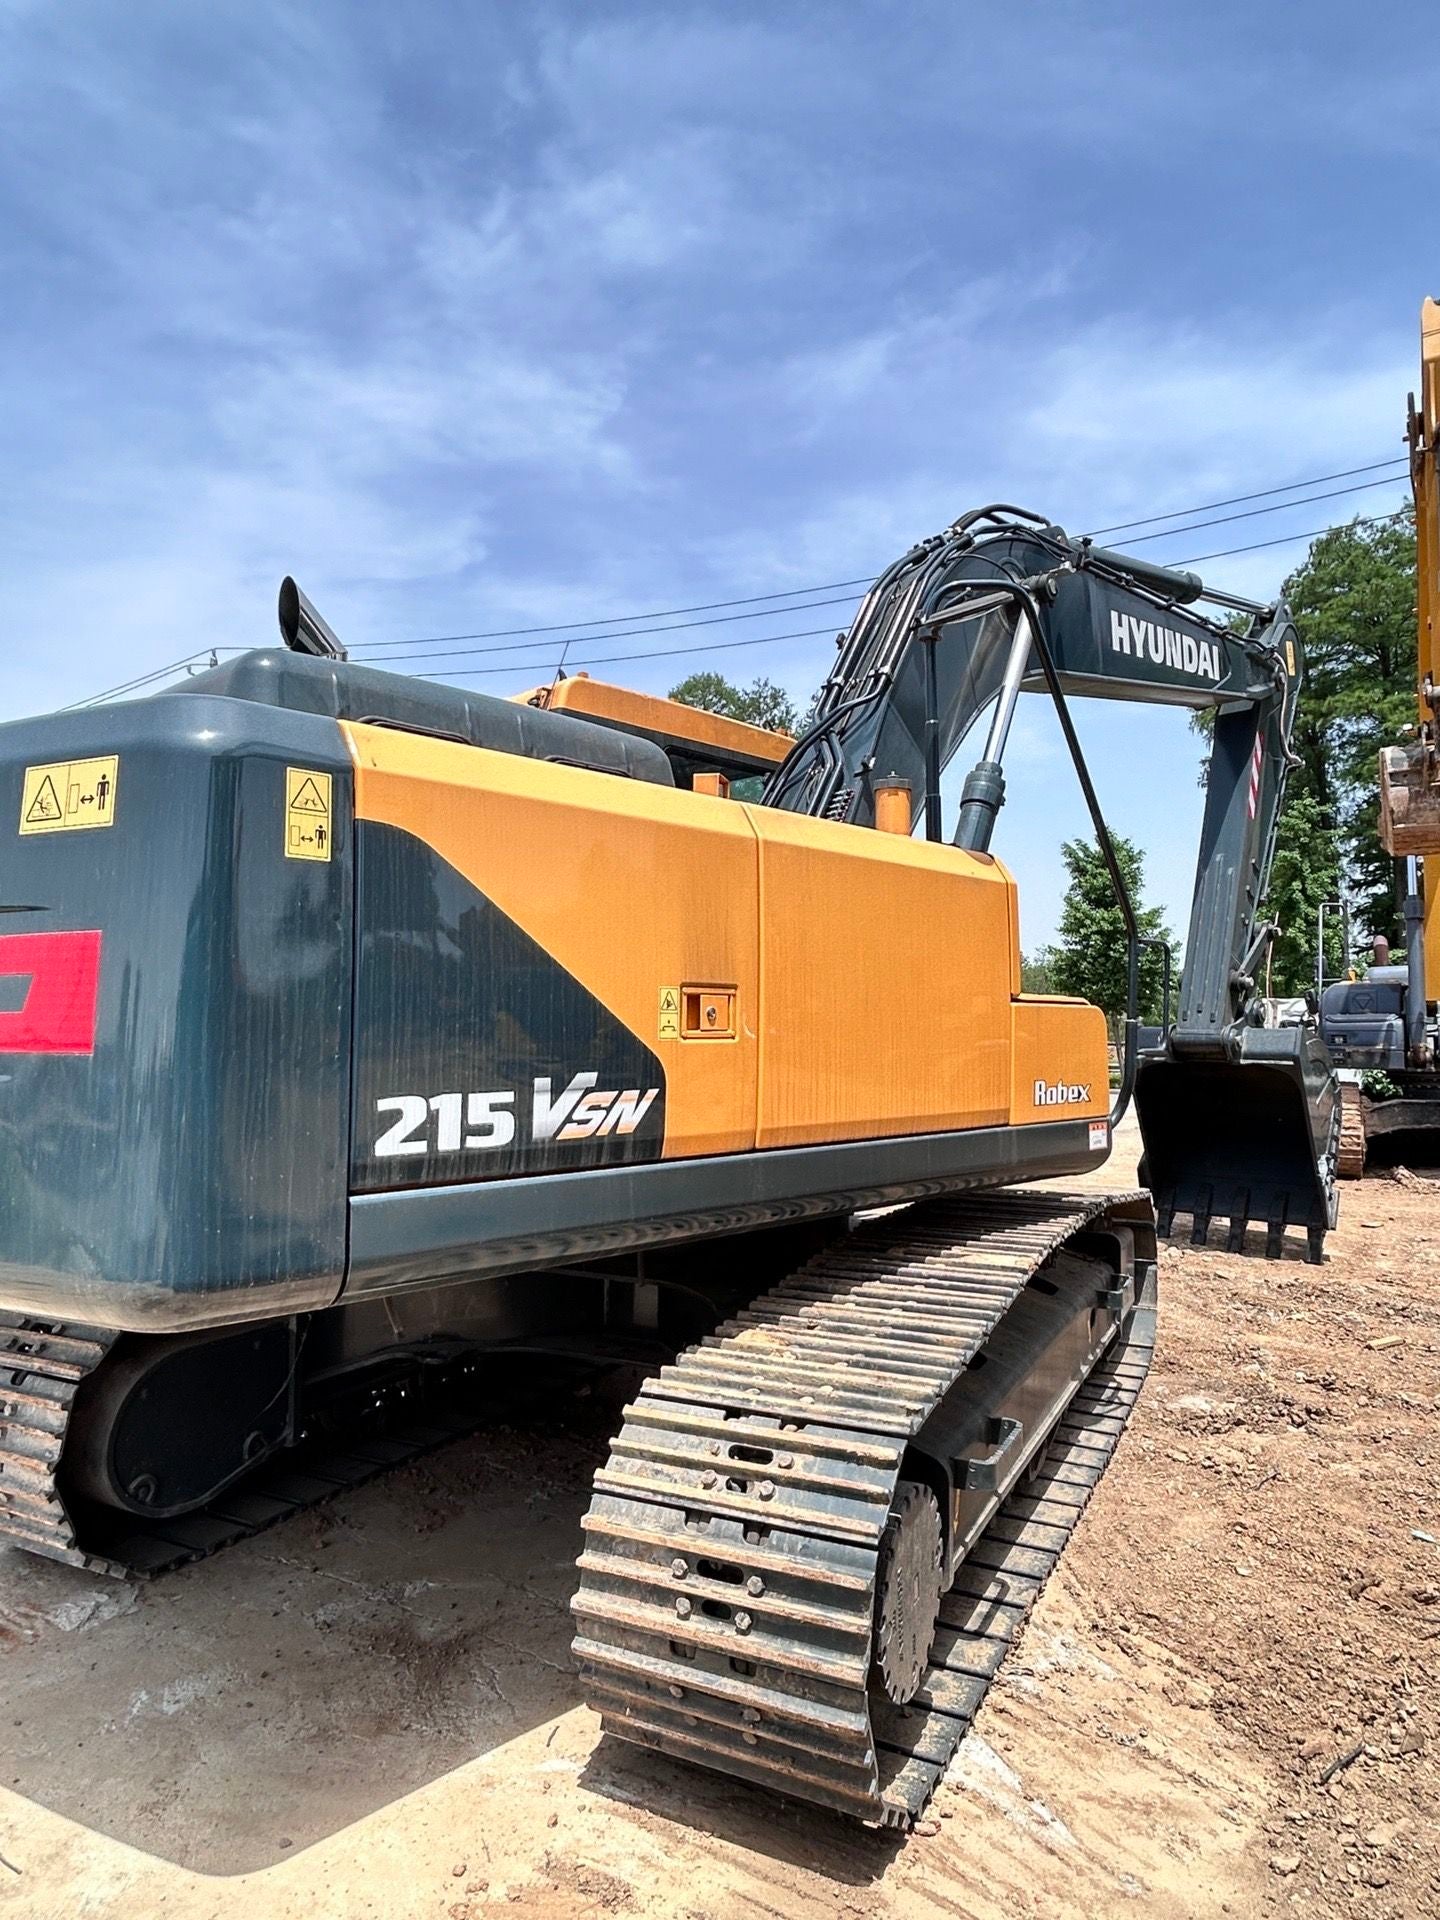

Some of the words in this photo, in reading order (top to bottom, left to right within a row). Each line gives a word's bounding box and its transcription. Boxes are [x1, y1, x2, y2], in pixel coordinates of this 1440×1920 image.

[1110, 609, 1221, 681] HYUNDAI
[374, 1090, 515, 1157] 215
[1034, 1079, 1091, 1106] Robex
